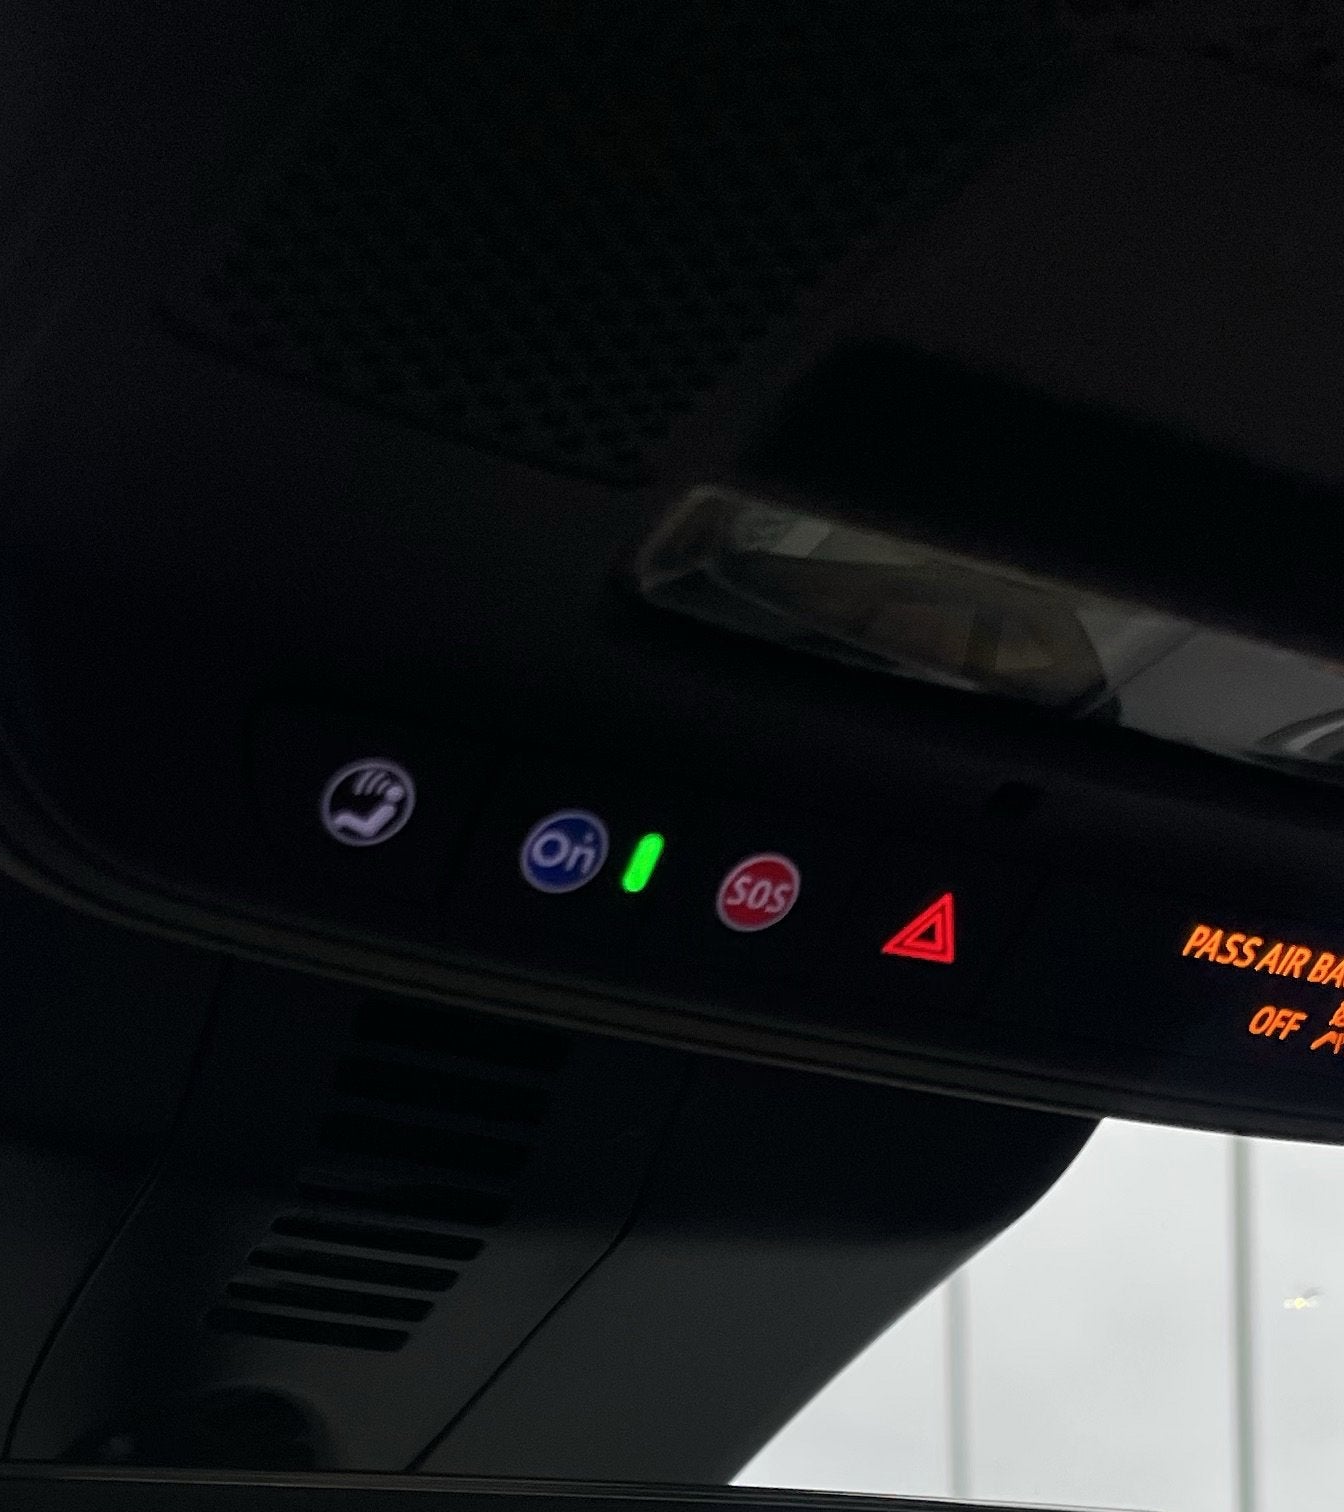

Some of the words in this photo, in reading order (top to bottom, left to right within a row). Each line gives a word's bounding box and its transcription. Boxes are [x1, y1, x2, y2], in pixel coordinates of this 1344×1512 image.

[532, 832, 596, 874] On
[726, 875, 791, 914] SOS
[1182, 924, 1264, 968] PASS
[1255, 942, 1312, 979] AIR
[1249, 1006, 1308, 1041] OFF
